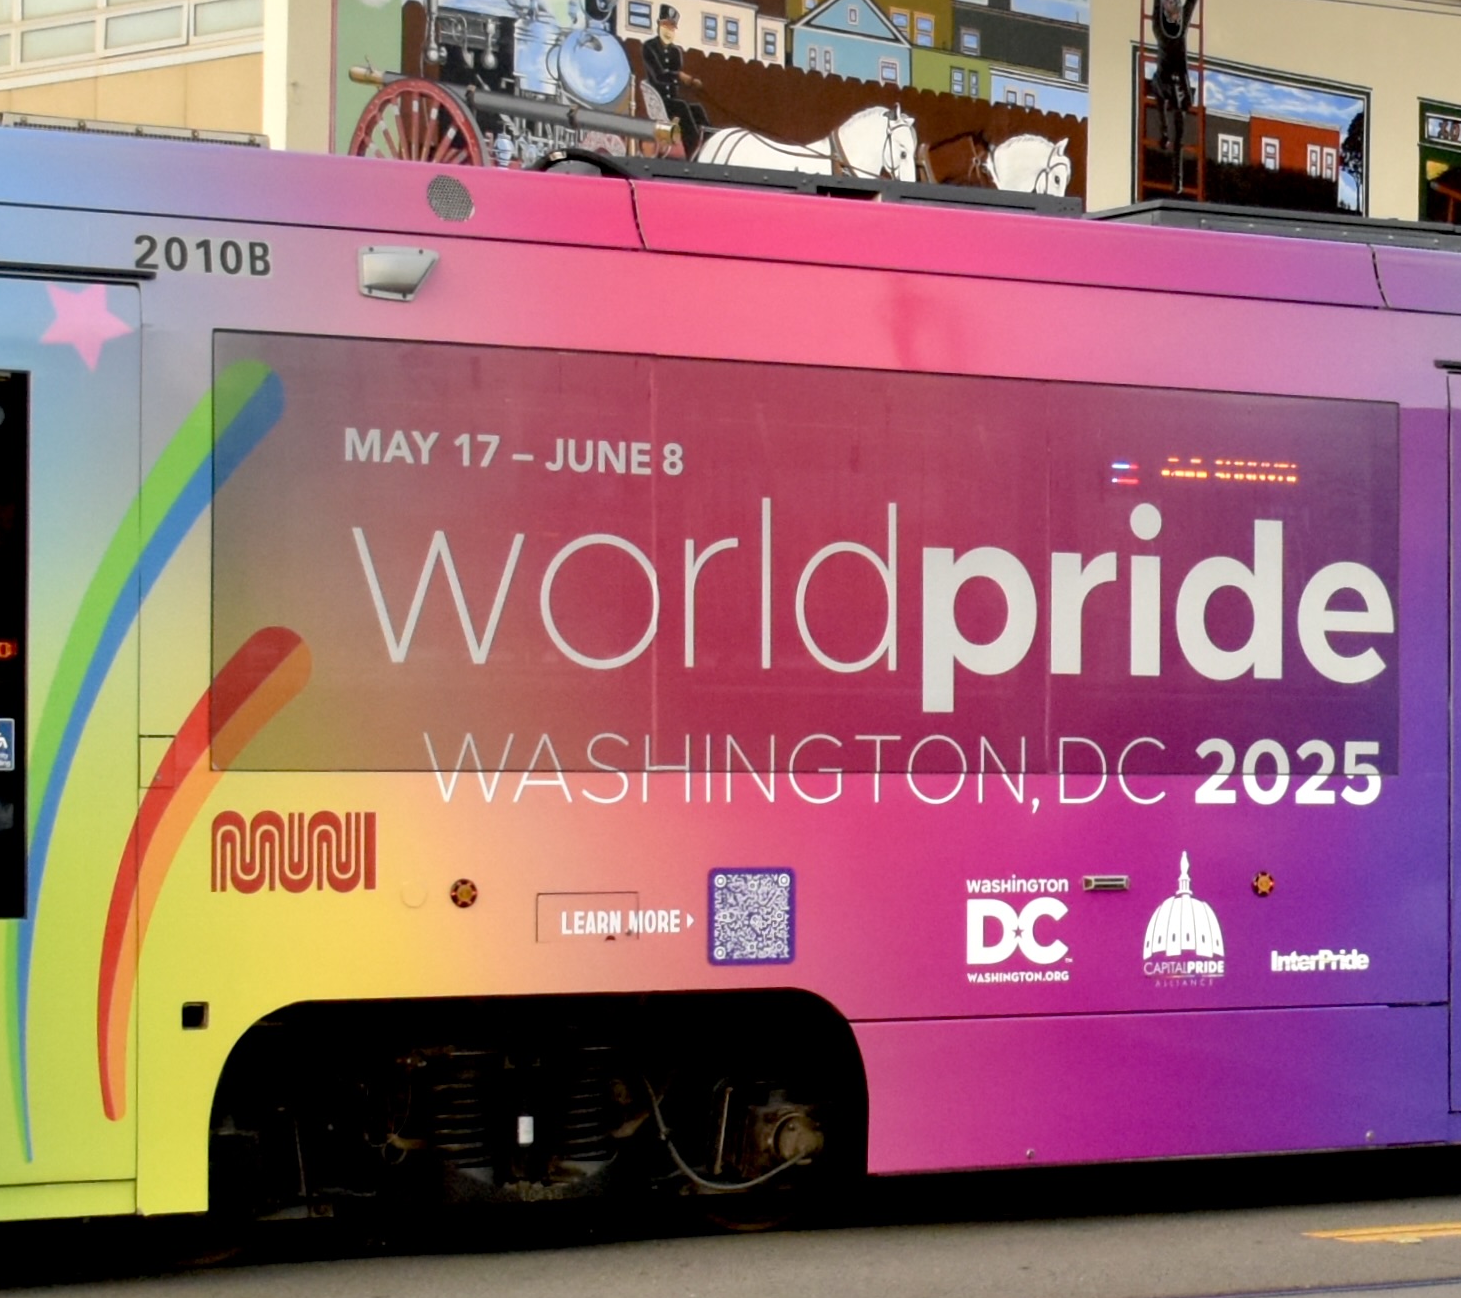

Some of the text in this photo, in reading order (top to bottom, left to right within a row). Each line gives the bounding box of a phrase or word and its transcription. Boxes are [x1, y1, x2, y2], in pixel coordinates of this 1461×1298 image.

[134, 234, 272, 277] 2010B
[344, 428, 439, 464] MAY
[454, 433, 500, 467] 17
[545, 438, 651, 475] JUNE
[662, 443, 683, 476] 8
[352, 497, 1395, 713] worldpride
[1195, 737, 1383, 806] 2025
[561, 909, 681, 935] LEARN MORE
[967, 897, 1069, 965] DC
[966, 970, 1070, 984] WASHINGTON.ORG
[1270, 949, 1370, 972] InterPride
